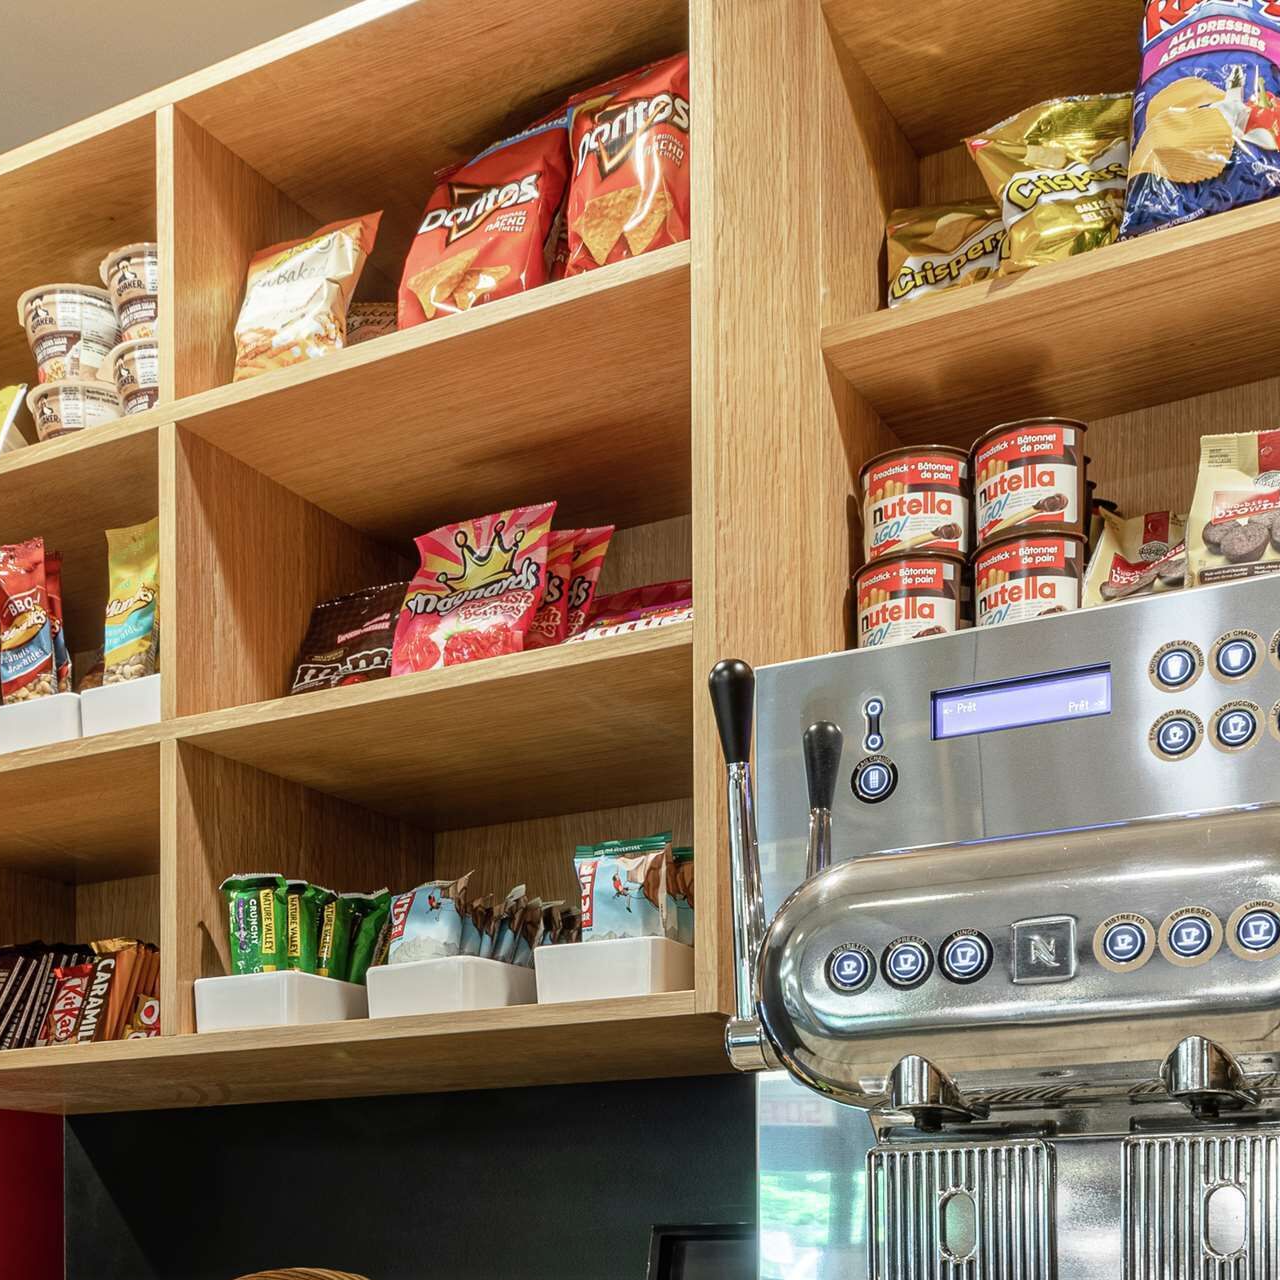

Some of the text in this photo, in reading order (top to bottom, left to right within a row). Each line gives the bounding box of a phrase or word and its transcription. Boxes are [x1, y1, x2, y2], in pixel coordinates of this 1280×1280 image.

[1169, 29, 1194, 48] ALL
[1197, 19, 1261, 36] DRESSED
[1159, 32, 1266, 66] ASSAISONNÉES
[577, 94, 690, 176] Doritos
[1008, 163, 1129, 211] Crispers
[417, 172, 542, 235] Doritos
[484, 216, 526, 232] NACHO
[1017, 433, 1057, 446] Bâtonnet
[1021, 442, 1054, 453] de pain
[917, 462, 954, 473] Bâtonnet
[920, 470, 951, 480] de pain
[979, 463, 1056, 507] nutella
[873, 491, 952, 525] nutella
[1018, 546, 1058, 556] Bâtonnet
[1022, 554, 1055, 564] de pain
[899, 567, 936, 578] Bâtonnet
[903, 576, 934, 585] de pain
[979, 576, 1056, 616] nutella
[862, 597, 935, 633] nutella
[982, 604, 1011, 627] GO!
[1233, 630, 1258, 640] CHAUD
[1068, 700, 1089, 712] Prêt
[1215, 700, 1259, 716] CAPPUCCINO
[1175, 709, 1204, 735] MACCHIATO
[1170, 907, 1212, 921] ESPRESSO
[1244, 900, 1275, 911] LUNGO
[249, 898, 258, 945] CRUNCHY
[263, 892, 274, 952] NATURE VALLEY
[289, 896, 299, 954] NATURE VALLEY
[1104, 914, 1145, 928] RISTRETTO
[78, 958, 115, 1042] CARAMIL
